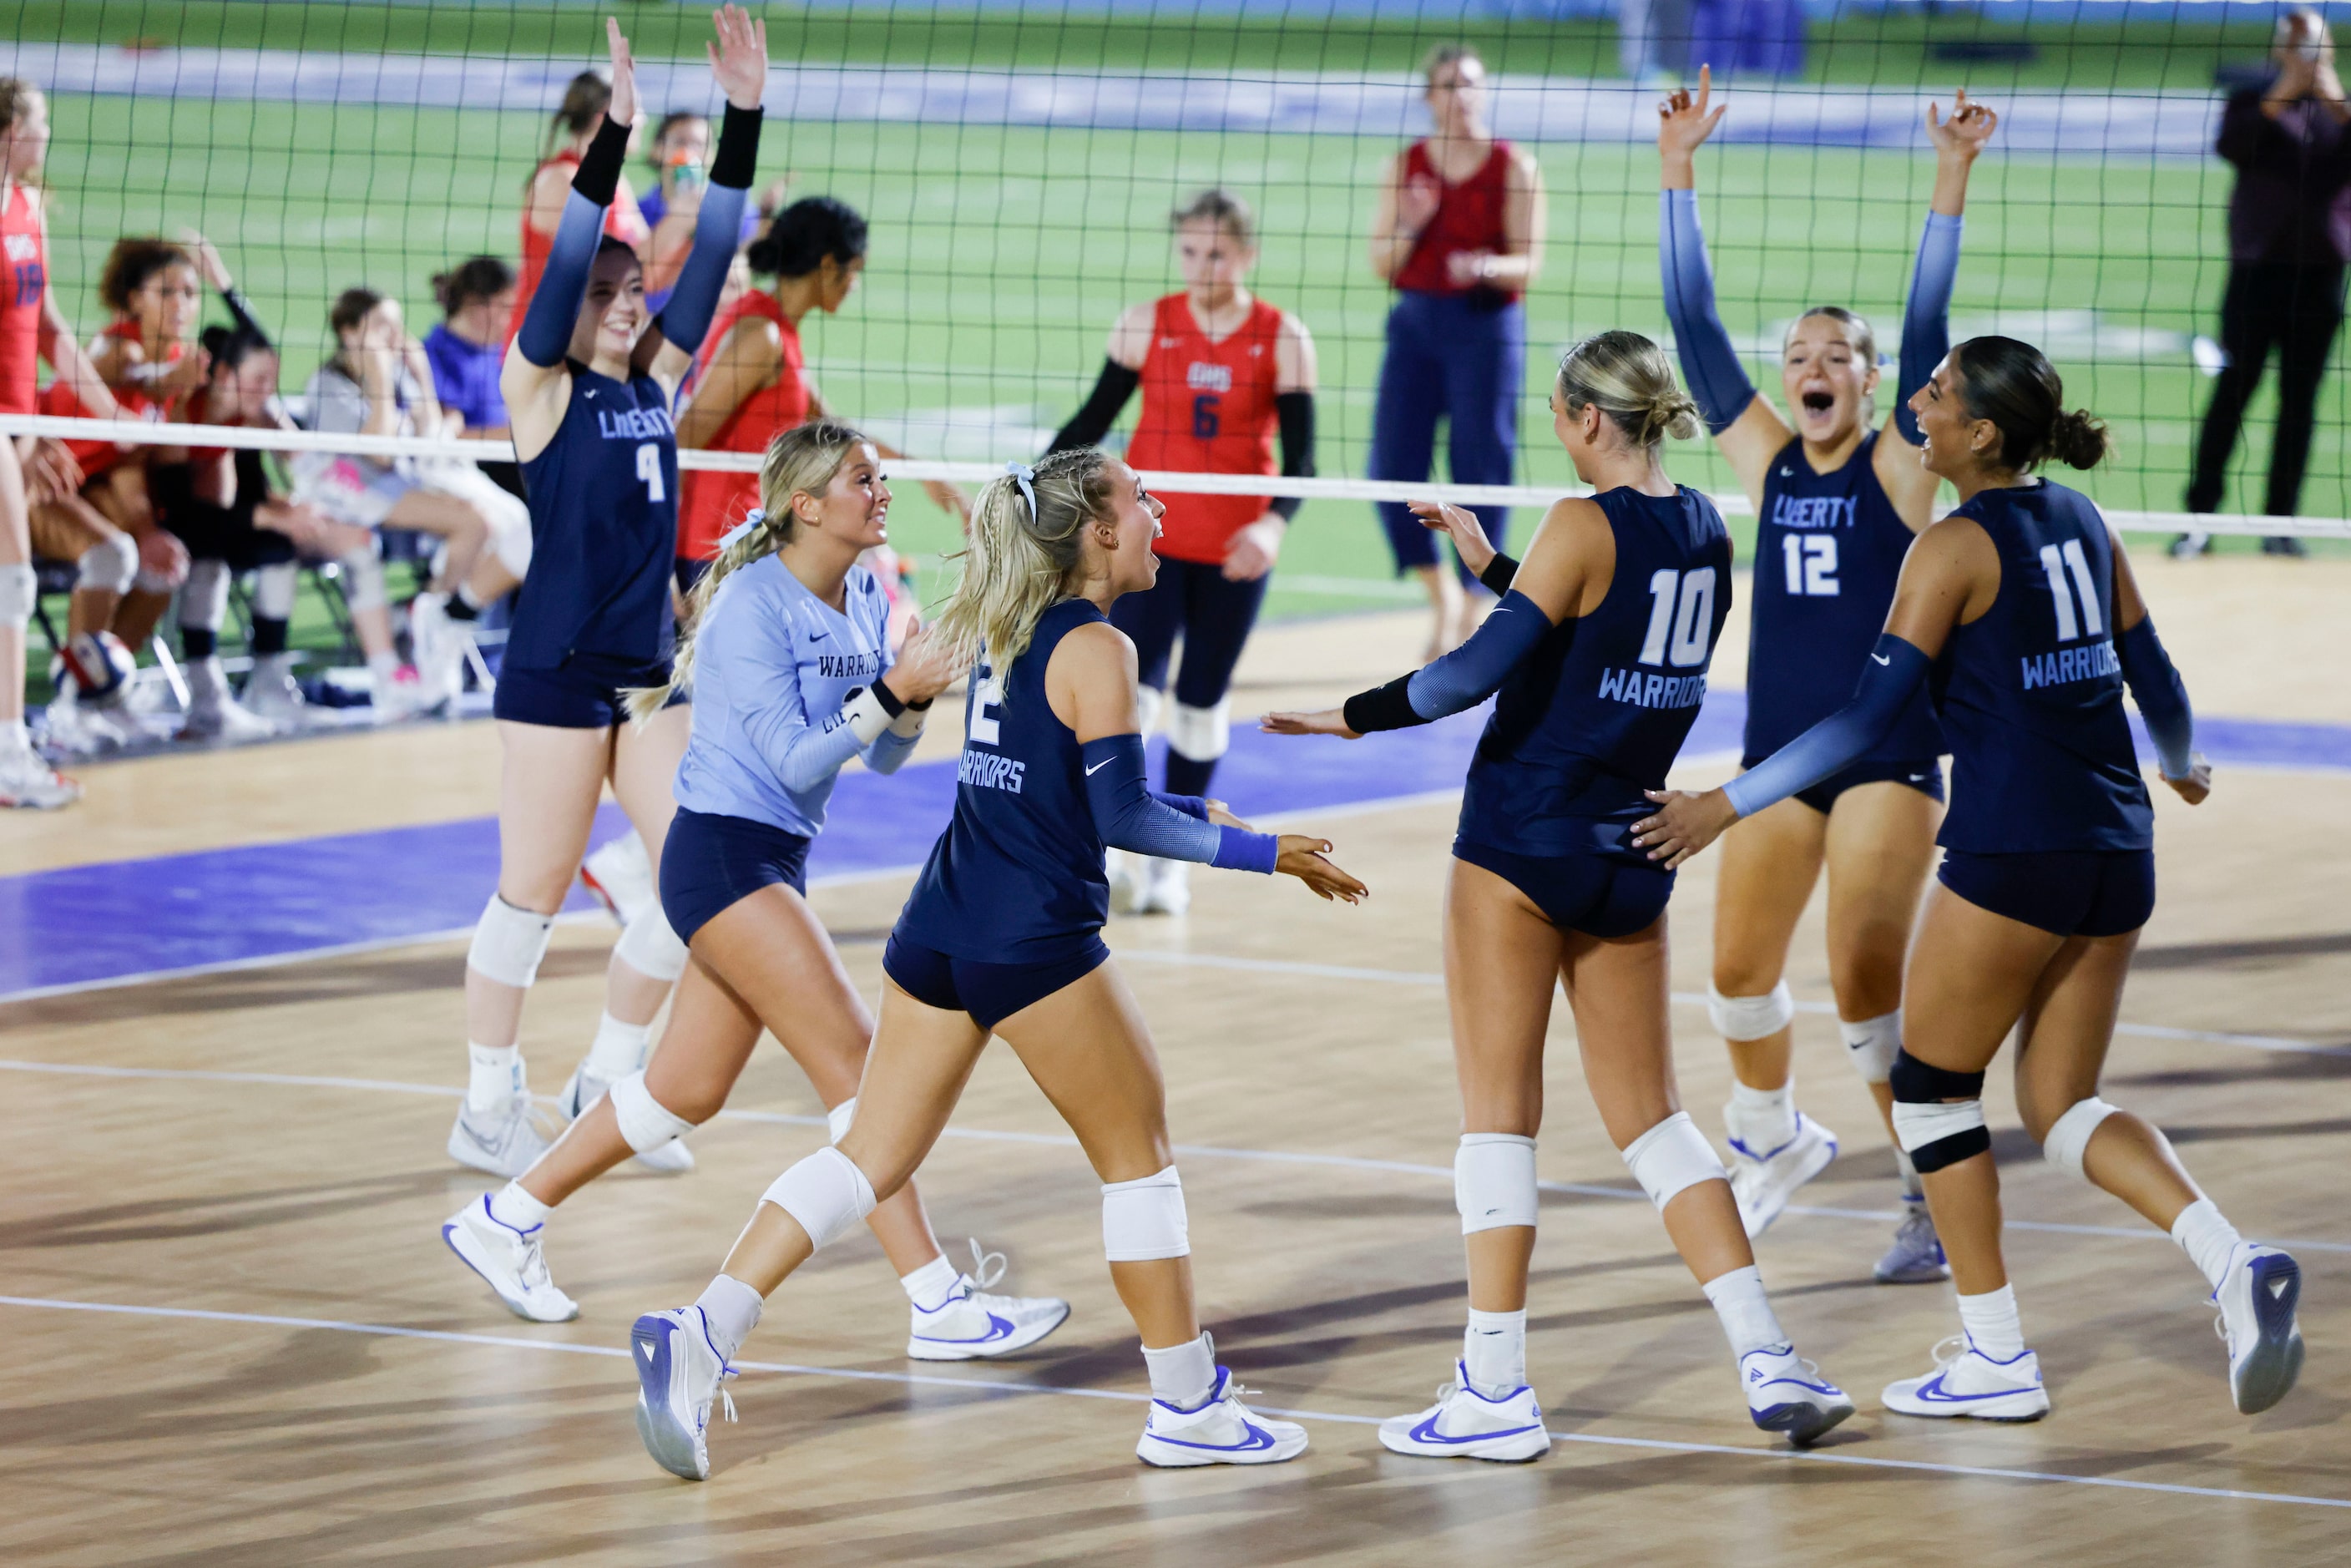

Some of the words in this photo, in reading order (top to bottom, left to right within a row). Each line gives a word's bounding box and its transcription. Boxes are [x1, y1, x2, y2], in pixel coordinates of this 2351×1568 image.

[1193, 395, 1221, 441] 6
[636, 443, 666, 503] 9
[1772, 493, 1858, 529] LIBERTY
[1782, 533, 1841, 596] 12
[2040, 539, 2103, 642] 11
[1638, 565, 1716, 668] 10
[968, 648, 1004, 746] 2
[1598, 667, 1708, 710] WARRIOR
[957, 748, 1025, 794] ARRIORS
